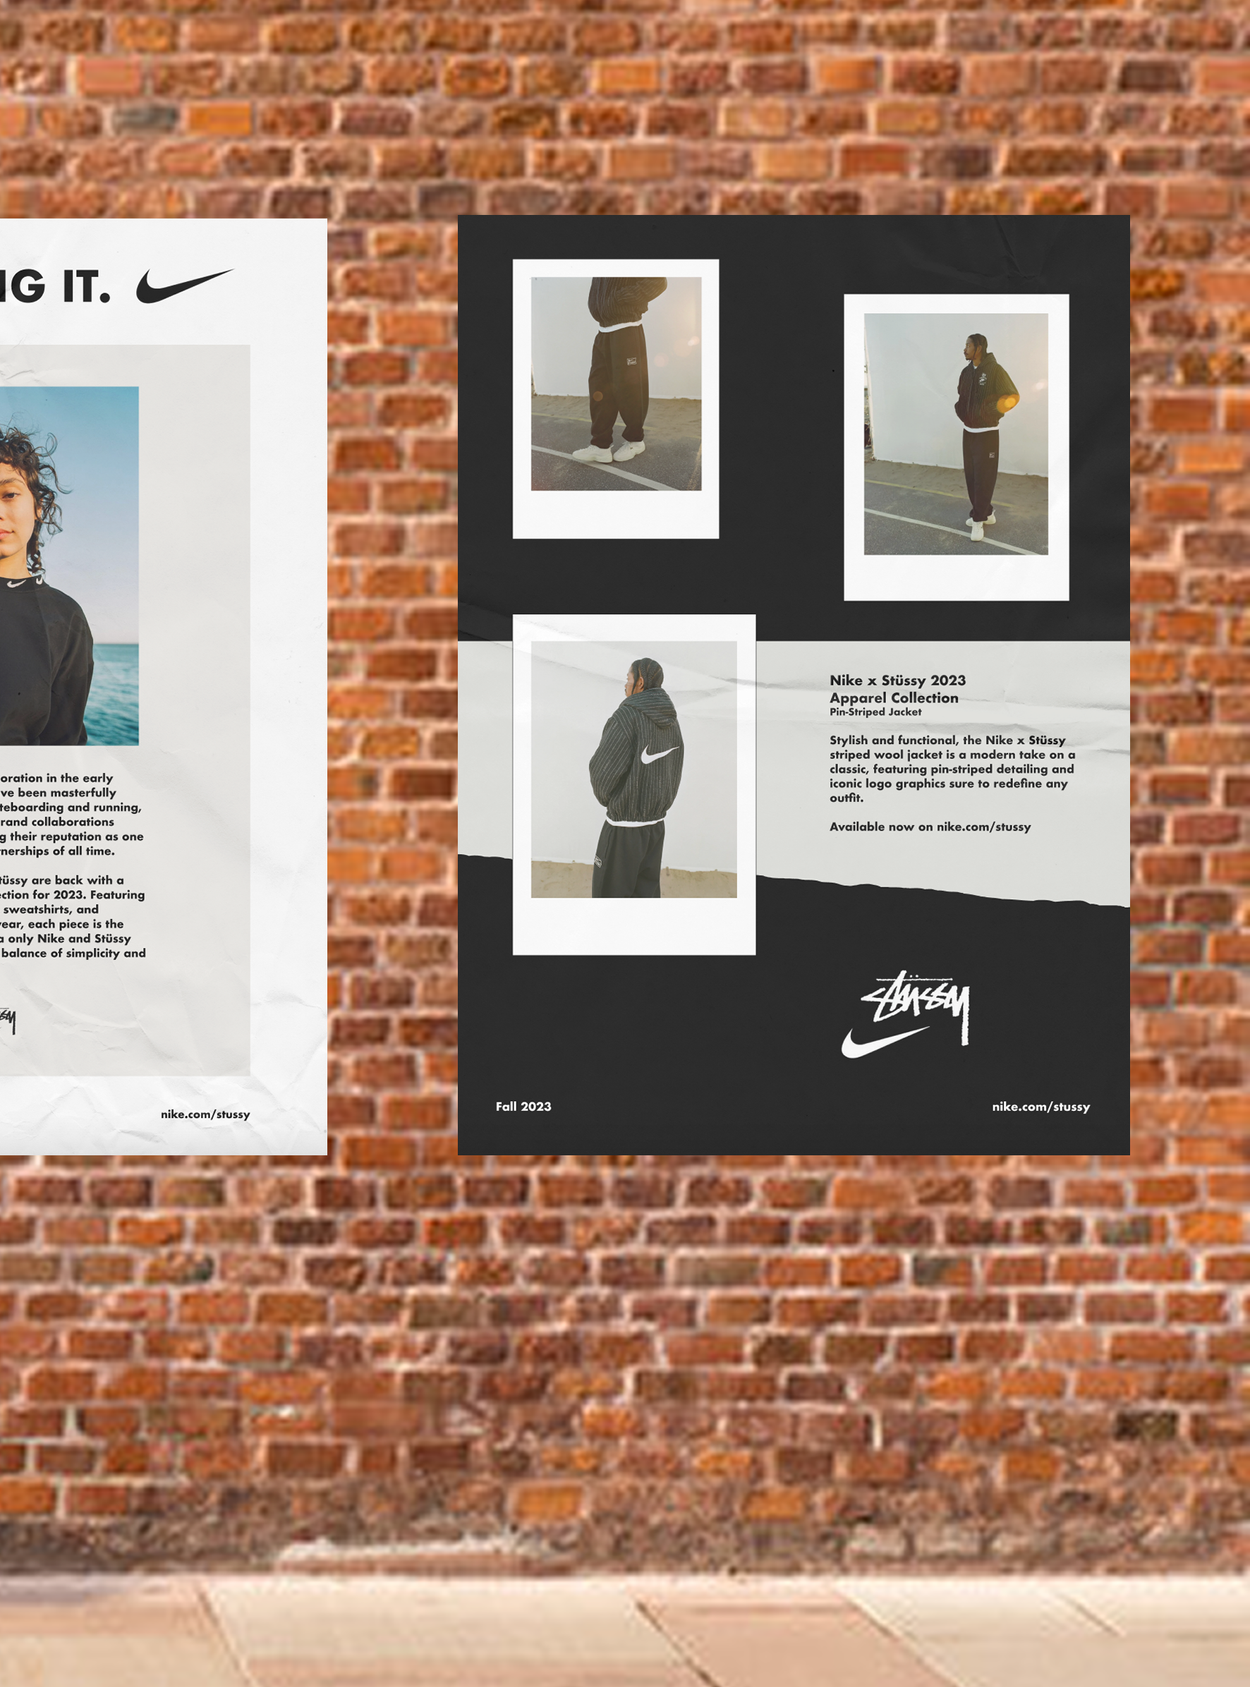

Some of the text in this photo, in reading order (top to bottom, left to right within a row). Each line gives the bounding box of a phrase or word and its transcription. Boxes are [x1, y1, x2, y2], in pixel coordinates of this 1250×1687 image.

[64, 270, 110, 303] IT.
[830, 673, 967, 690] Nike x Stüssy 2023
[829, 691, 959, 707] Apparel Collection
[829, 706, 923, 719] Pin-Striped Jacket
[829, 734, 1067, 748] Stylish and functional, the Nike x Stüssy
[829, 748, 1076, 763] striped wool jacket is a modern take on a
[829, 763, 1075, 777] classic, featuring pin-striped detailing and
[46, 772, 57, 783] in
[60, 772, 80, 783] the
[82, 772, 114, 786] early
[829, 777, 1069, 791] iconic logo graphics sure to redefine any
[17, 786, 47, 798] been
[50, 786, 117, 800] masterfully
[829, 791, 864, 803] outfit.
[67, 801, 90, 812] and
[93, 801, 142, 815] running,
[31, 816, 115, 827] collaborations
[829, 820, 1032, 835] Available now on nike.com/stussy
[9, 830, 38, 842] their
[40, 831, 102, 844] reputation
[105, 833, 119, 842] as
[121, 833, 144, 842] one
[52, 845, 66, 856] of
[68, 845, 83, 856] all
[85, 845, 115, 856] time.
[31, 877, 52, 886] are
[54, 874, 84, 885] back
[86, 874, 113, 885] with
[116, 877, 124, 885] a
[32, 889, 51, 900] for
[53, 889, 87, 900] 2023.
[90, 889, 145, 903] Featuring
[3, 903, 73, 916] sweatshirts,
[76, 903, 99, 915] and
[27, 918, 56, 929] each
[59, 918, 90, 932] piece
[92, 918, 102, 929] is
[105, 918, 124, 929] the
[7, 932, 34, 946] only
[37, 932, 65, 944] Nike
[68, 932, 91, 944] and
[94, 933, 132, 946] Stüssy
[1, 947, 47, 958] balance
[50, 947, 63, 958] of
[65, 947, 121, 961] simplicity
[123, 947, 146, 958] and
[496, 1100, 552, 1112] Fall 2023
[992, 1100, 1091, 1115] nike.com/stussy
[161, 1108, 251, 1122] nike.com/stussy
